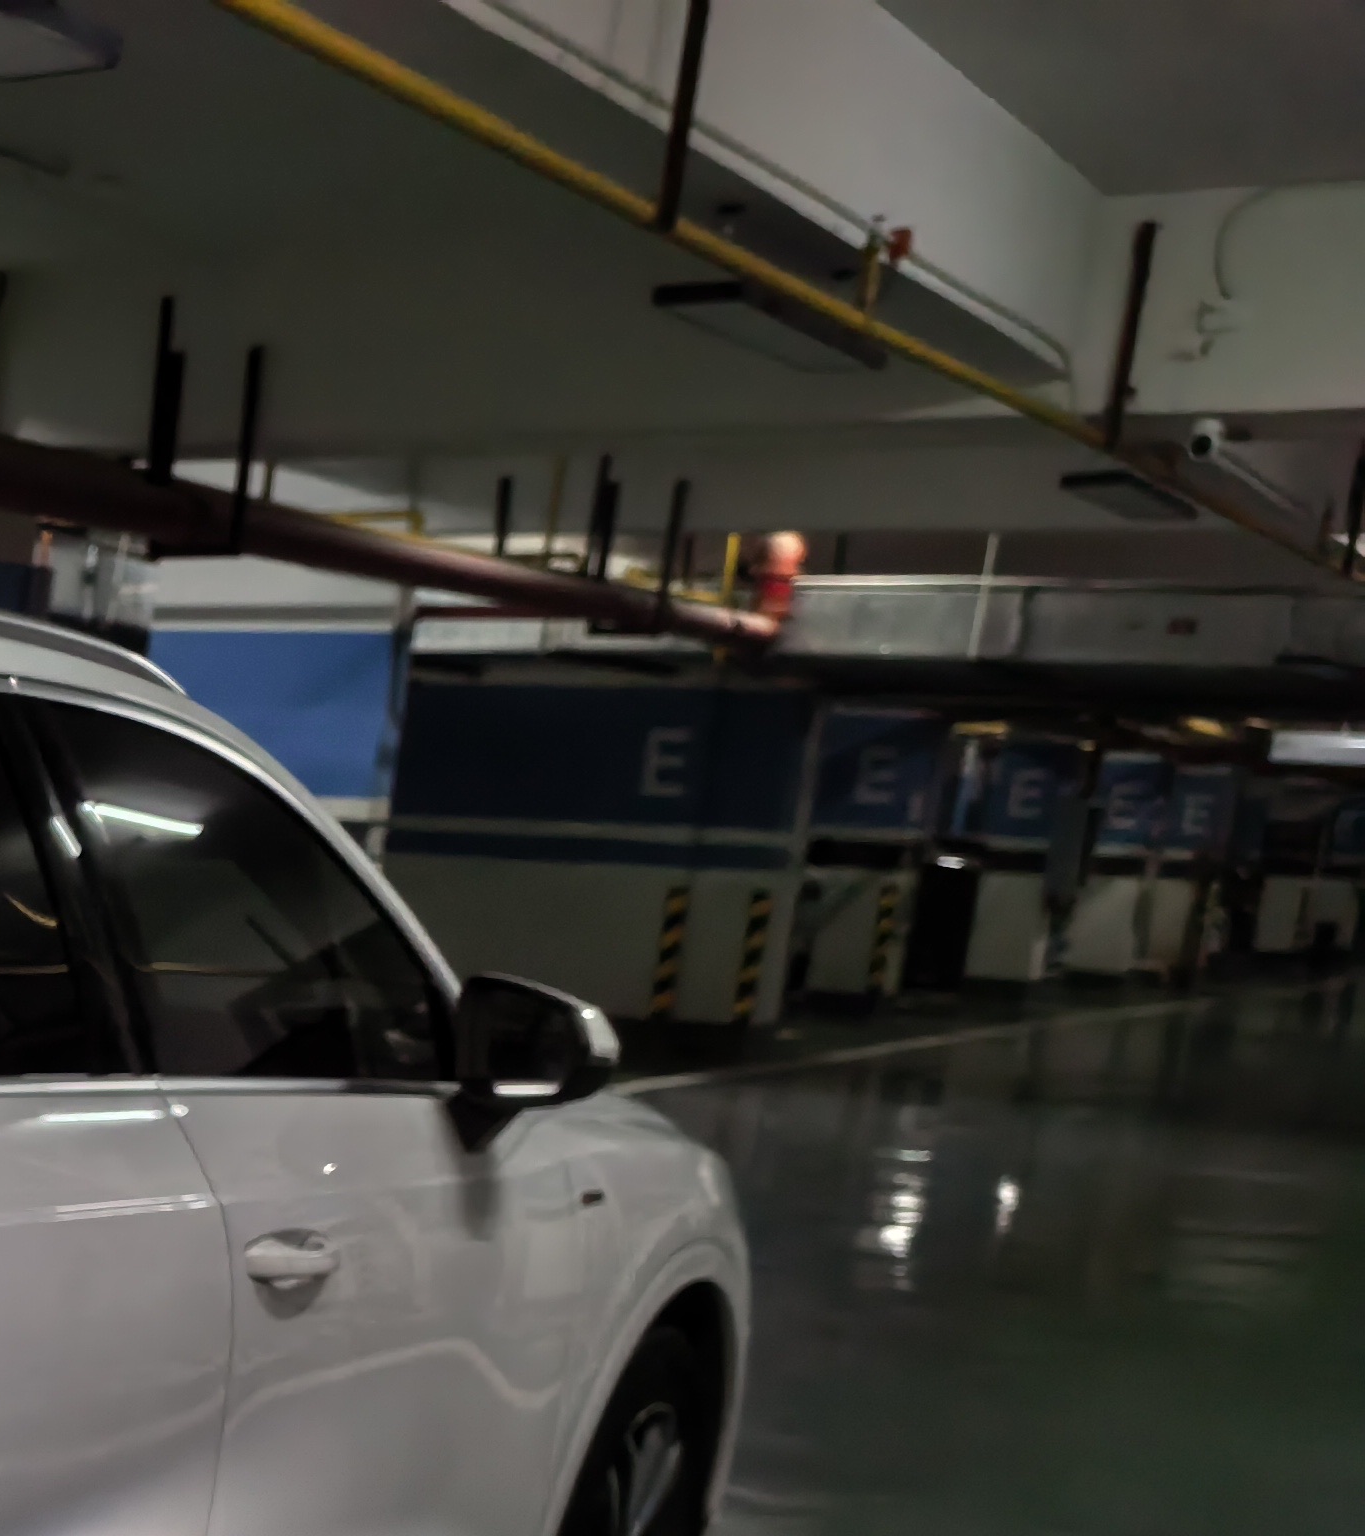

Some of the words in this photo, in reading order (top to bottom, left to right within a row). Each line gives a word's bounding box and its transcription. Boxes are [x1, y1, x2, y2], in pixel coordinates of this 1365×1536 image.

[640, 727, 692, 797] E
[853, 746, 899, 804] E
[1007, 768, 1050, 819] E
